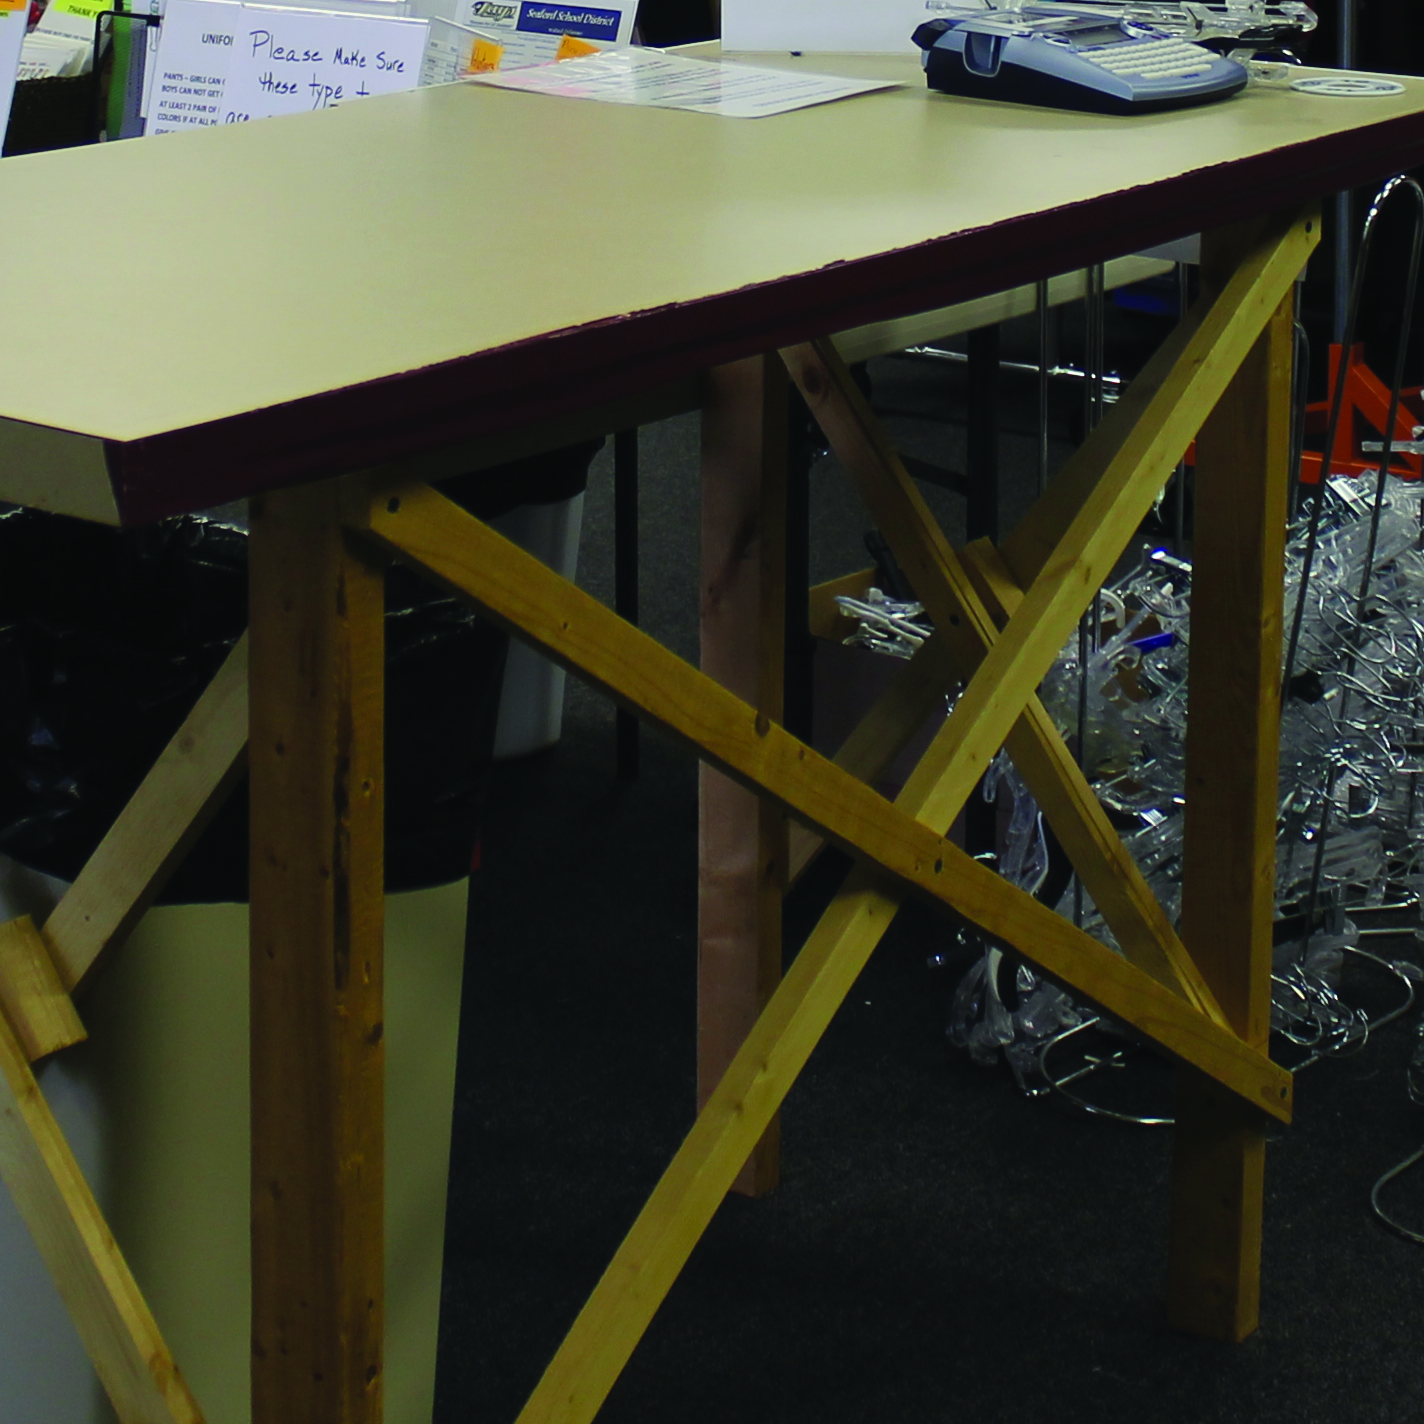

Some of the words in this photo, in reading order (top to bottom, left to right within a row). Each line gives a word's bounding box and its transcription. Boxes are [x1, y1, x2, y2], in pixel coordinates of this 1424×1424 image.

[526, 8, 557, 20] Seaford
[557, 11, 584, 23] School
[584, 14, 615, 27] District
[202, 34, 234, 46] UNIFO
[249, 30, 323, 62] Please
[376, 51, 404, 72] Sure
[164, 72, 183, 81] PANTS
[190, 75, 206, 83] GIRLS
[207, 76, 221, 85] CAN
[161, 85, 178, 94] BOYS
[179, 86, 191, 95] CAN
[193, 87, 206, 95] NOT
[207, 89, 220, 97] GET
[259, 71, 298, 94] these
[309, 73, 343, 110] type
[168, 102, 186, 110] LEAST
[193, 104, 207, 112] PAIR
[157, 113, 181, 123] COLORS
[189, 116, 197, 124] AT
[198, 117, 209, 126] ALL
